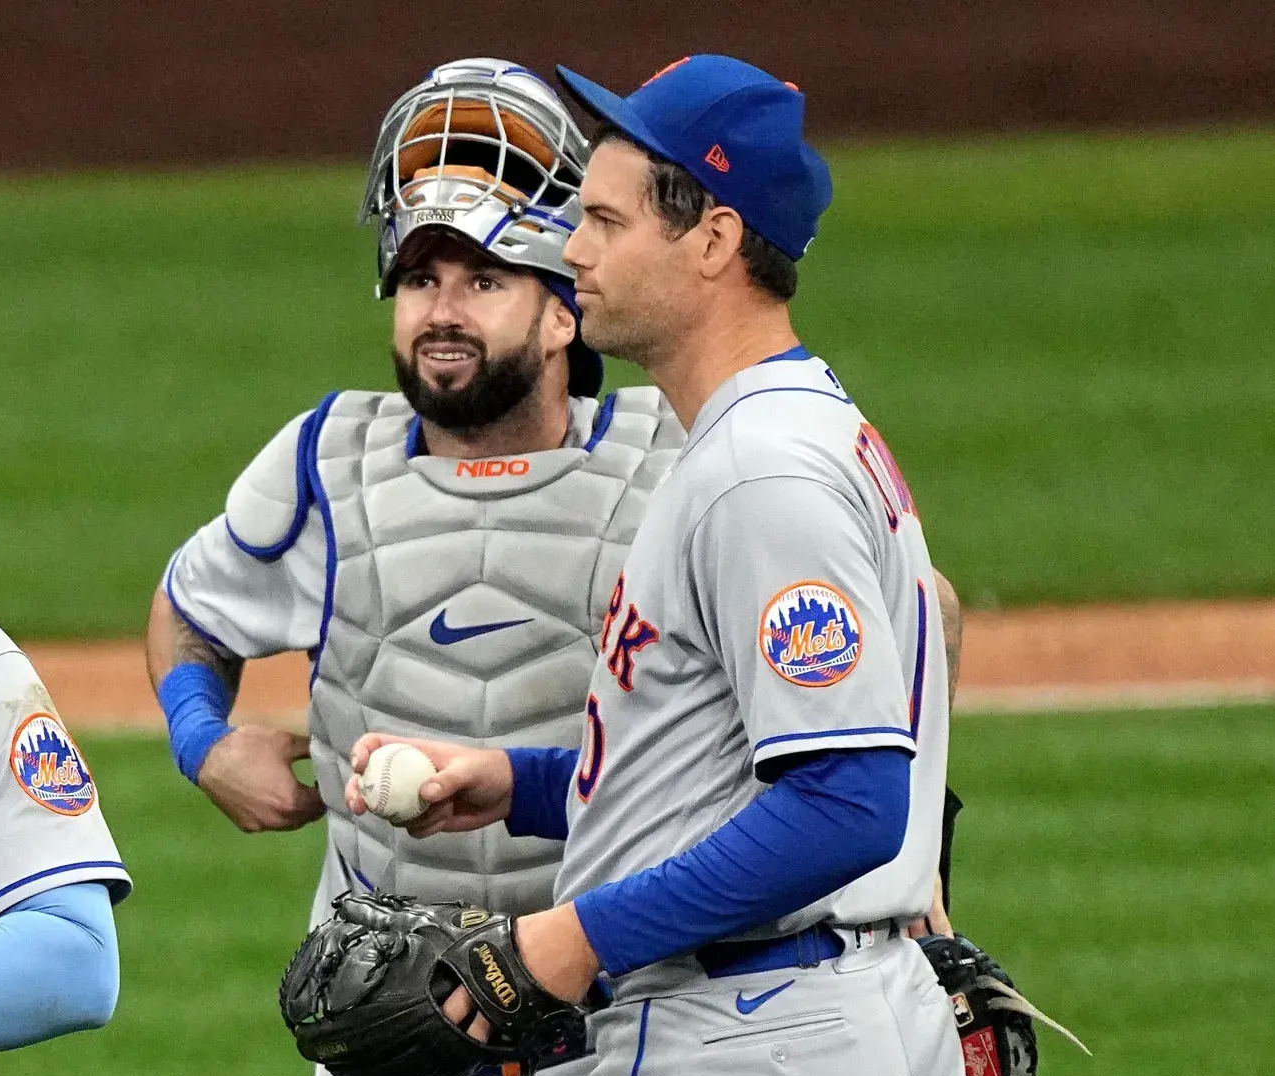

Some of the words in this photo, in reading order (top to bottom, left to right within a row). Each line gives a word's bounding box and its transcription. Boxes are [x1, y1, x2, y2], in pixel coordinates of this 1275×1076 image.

[455, 459, 529, 478] NIDO
[780, 619, 847, 664] Mets
[30, 752, 83, 788] Mets
[472, 943, 518, 1008] Wilson
